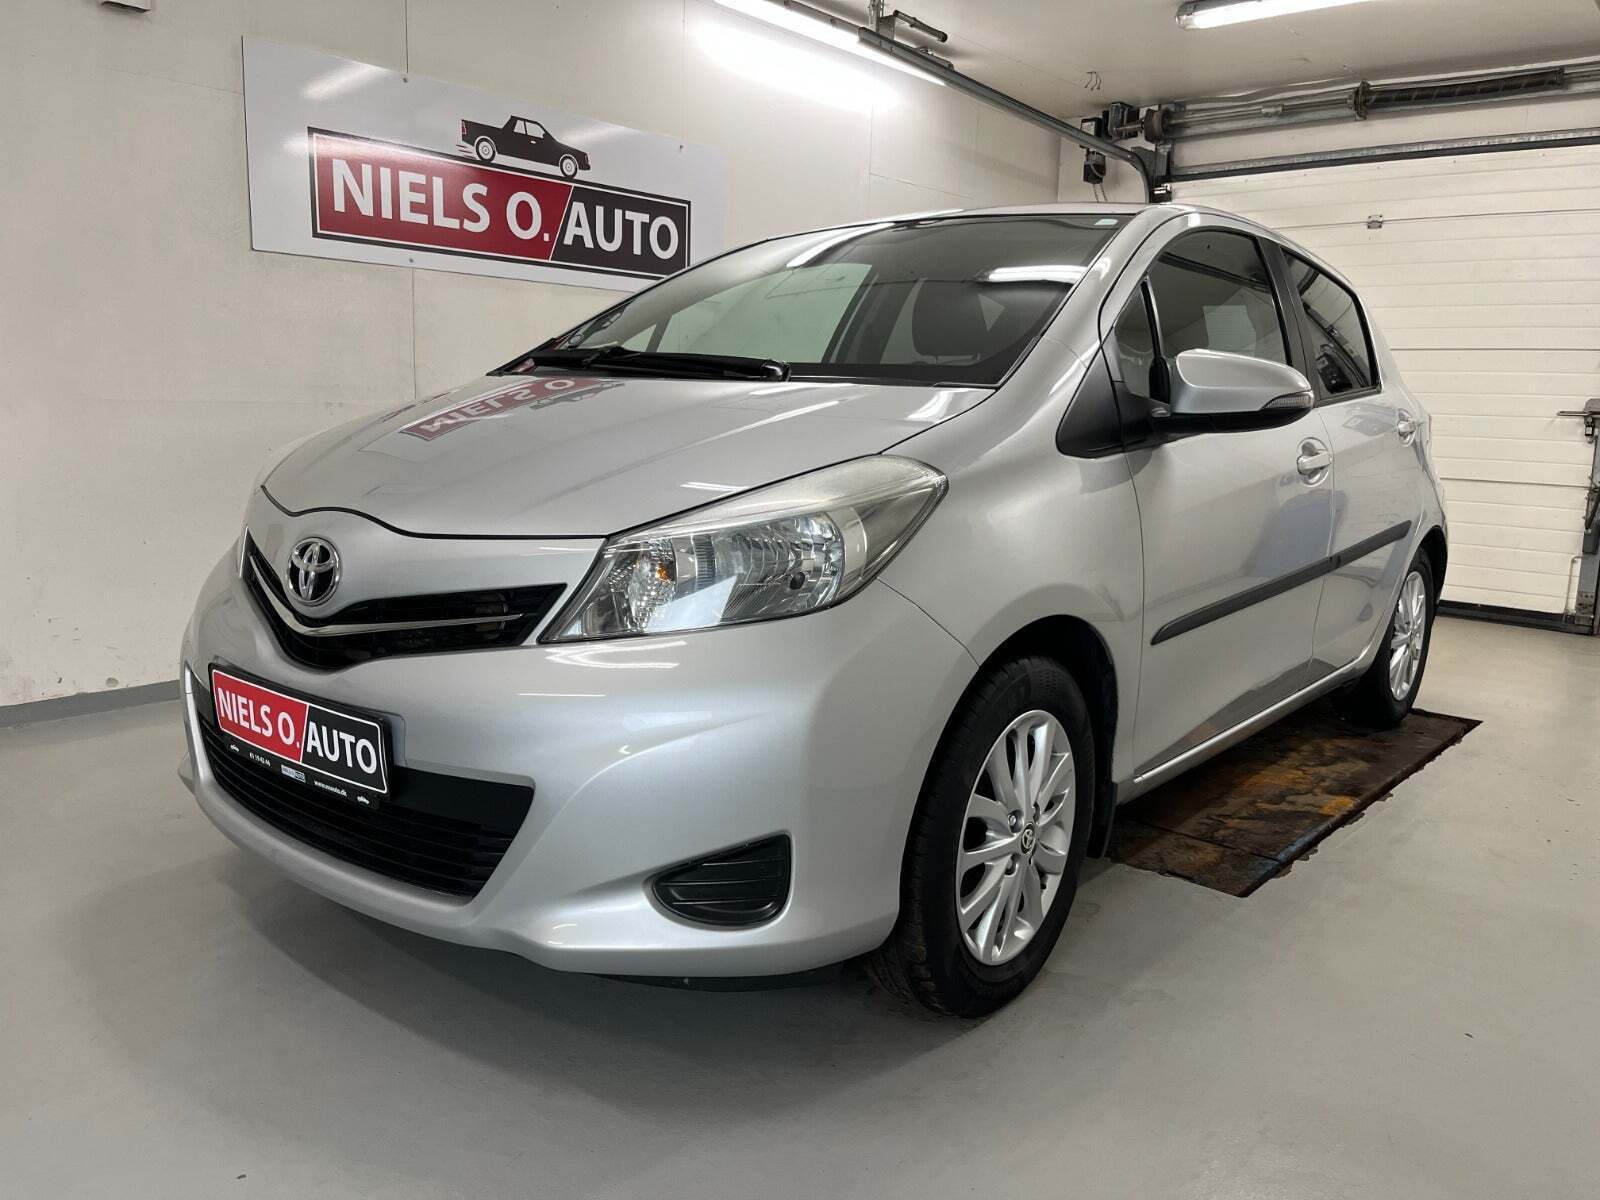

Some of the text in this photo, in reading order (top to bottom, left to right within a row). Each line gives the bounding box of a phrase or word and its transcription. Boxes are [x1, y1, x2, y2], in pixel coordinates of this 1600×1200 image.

[332, 159, 679, 259] NIELS O. AUTO
[217, 687, 377, 774] NIELS O. AUTO
